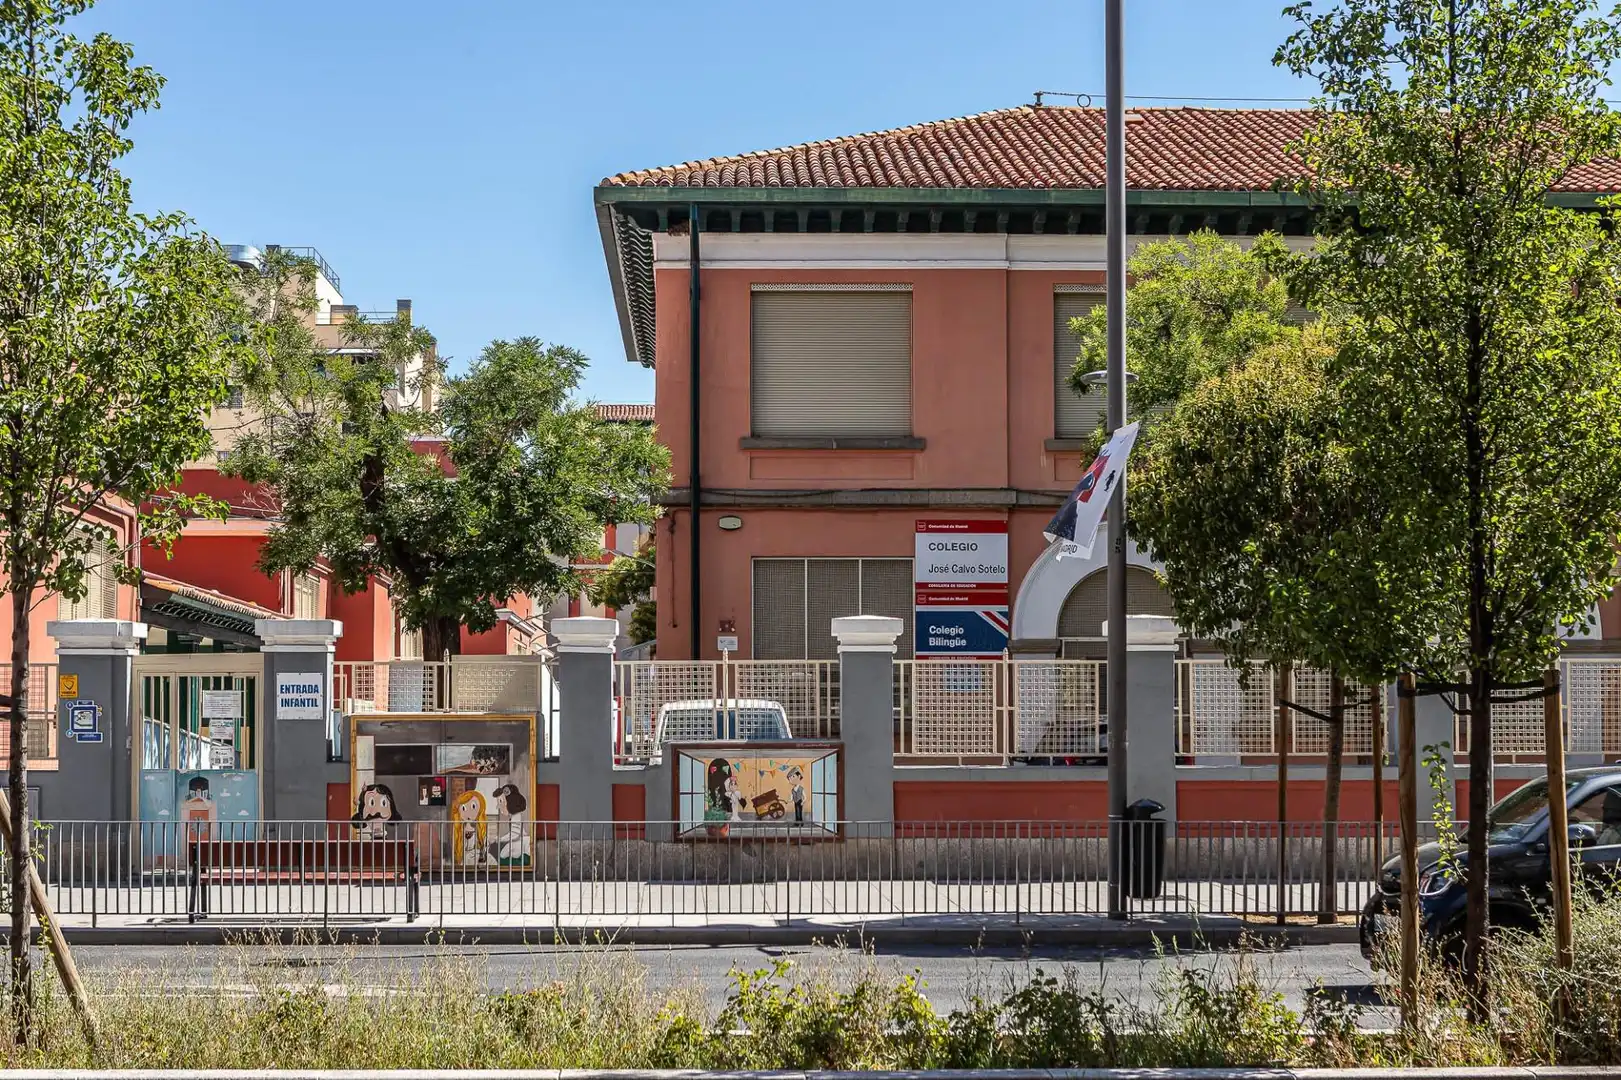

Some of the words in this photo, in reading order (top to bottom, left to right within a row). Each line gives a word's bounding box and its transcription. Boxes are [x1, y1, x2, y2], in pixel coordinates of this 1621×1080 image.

[928, 542, 978, 551] COLEGIO
[928, 563, 949, 574] José
[951, 563, 976, 574] Calvo
[978, 563, 1006, 574] Sotelo
[929, 625, 964, 636] Colegio
[928, 637, 967, 648] Bilingüe
[280, 684, 319, 694] ENTRADA
[281, 698, 319, 707] INFANTIL
